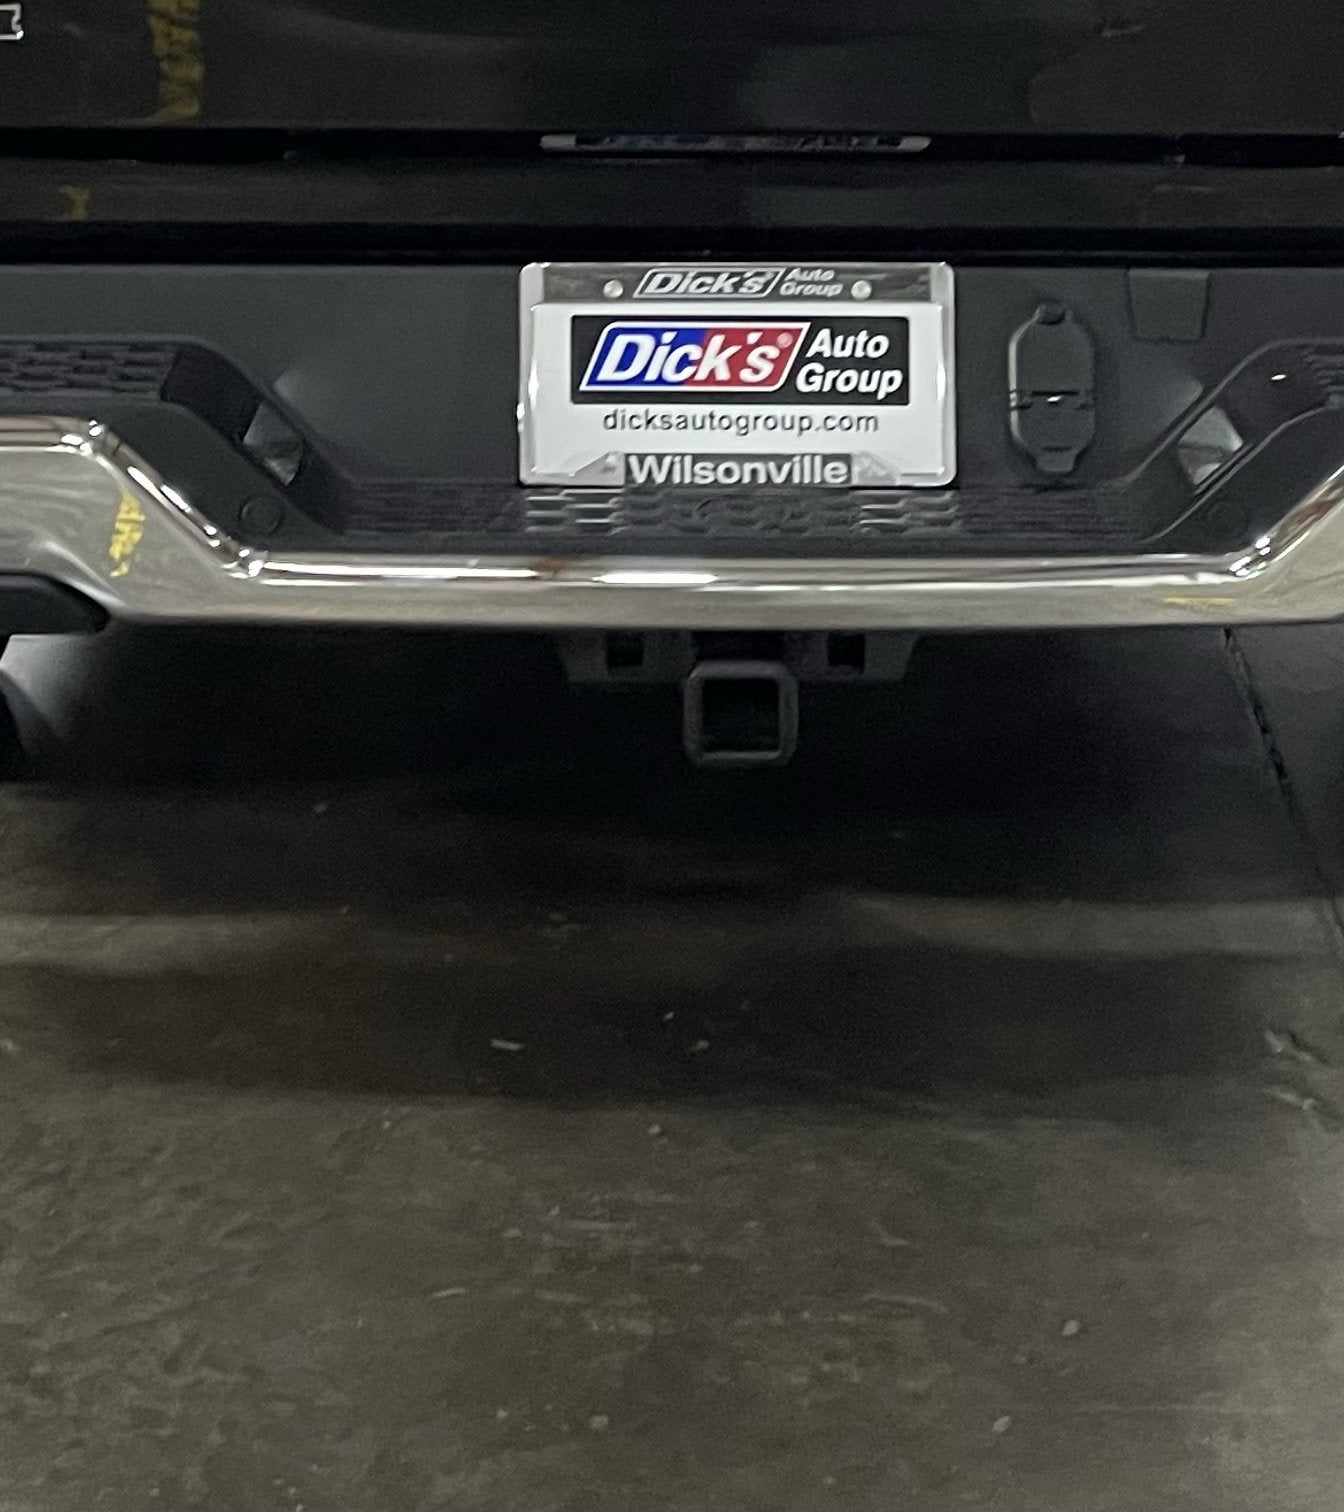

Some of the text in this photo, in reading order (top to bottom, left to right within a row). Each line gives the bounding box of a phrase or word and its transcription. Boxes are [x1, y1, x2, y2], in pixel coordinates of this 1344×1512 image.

[643, 270, 767, 295] Dick's
[780, 282, 843, 297] Group
[784, 268, 834, 282] Auto
[596, 331, 781, 383] Dick's
[806, 328, 889, 359] Auto
[795, 364, 903, 400] Group
[603, 409, 879, 436] dicksautogroup.com
[628, 454, 848, 485] Wilsonville
